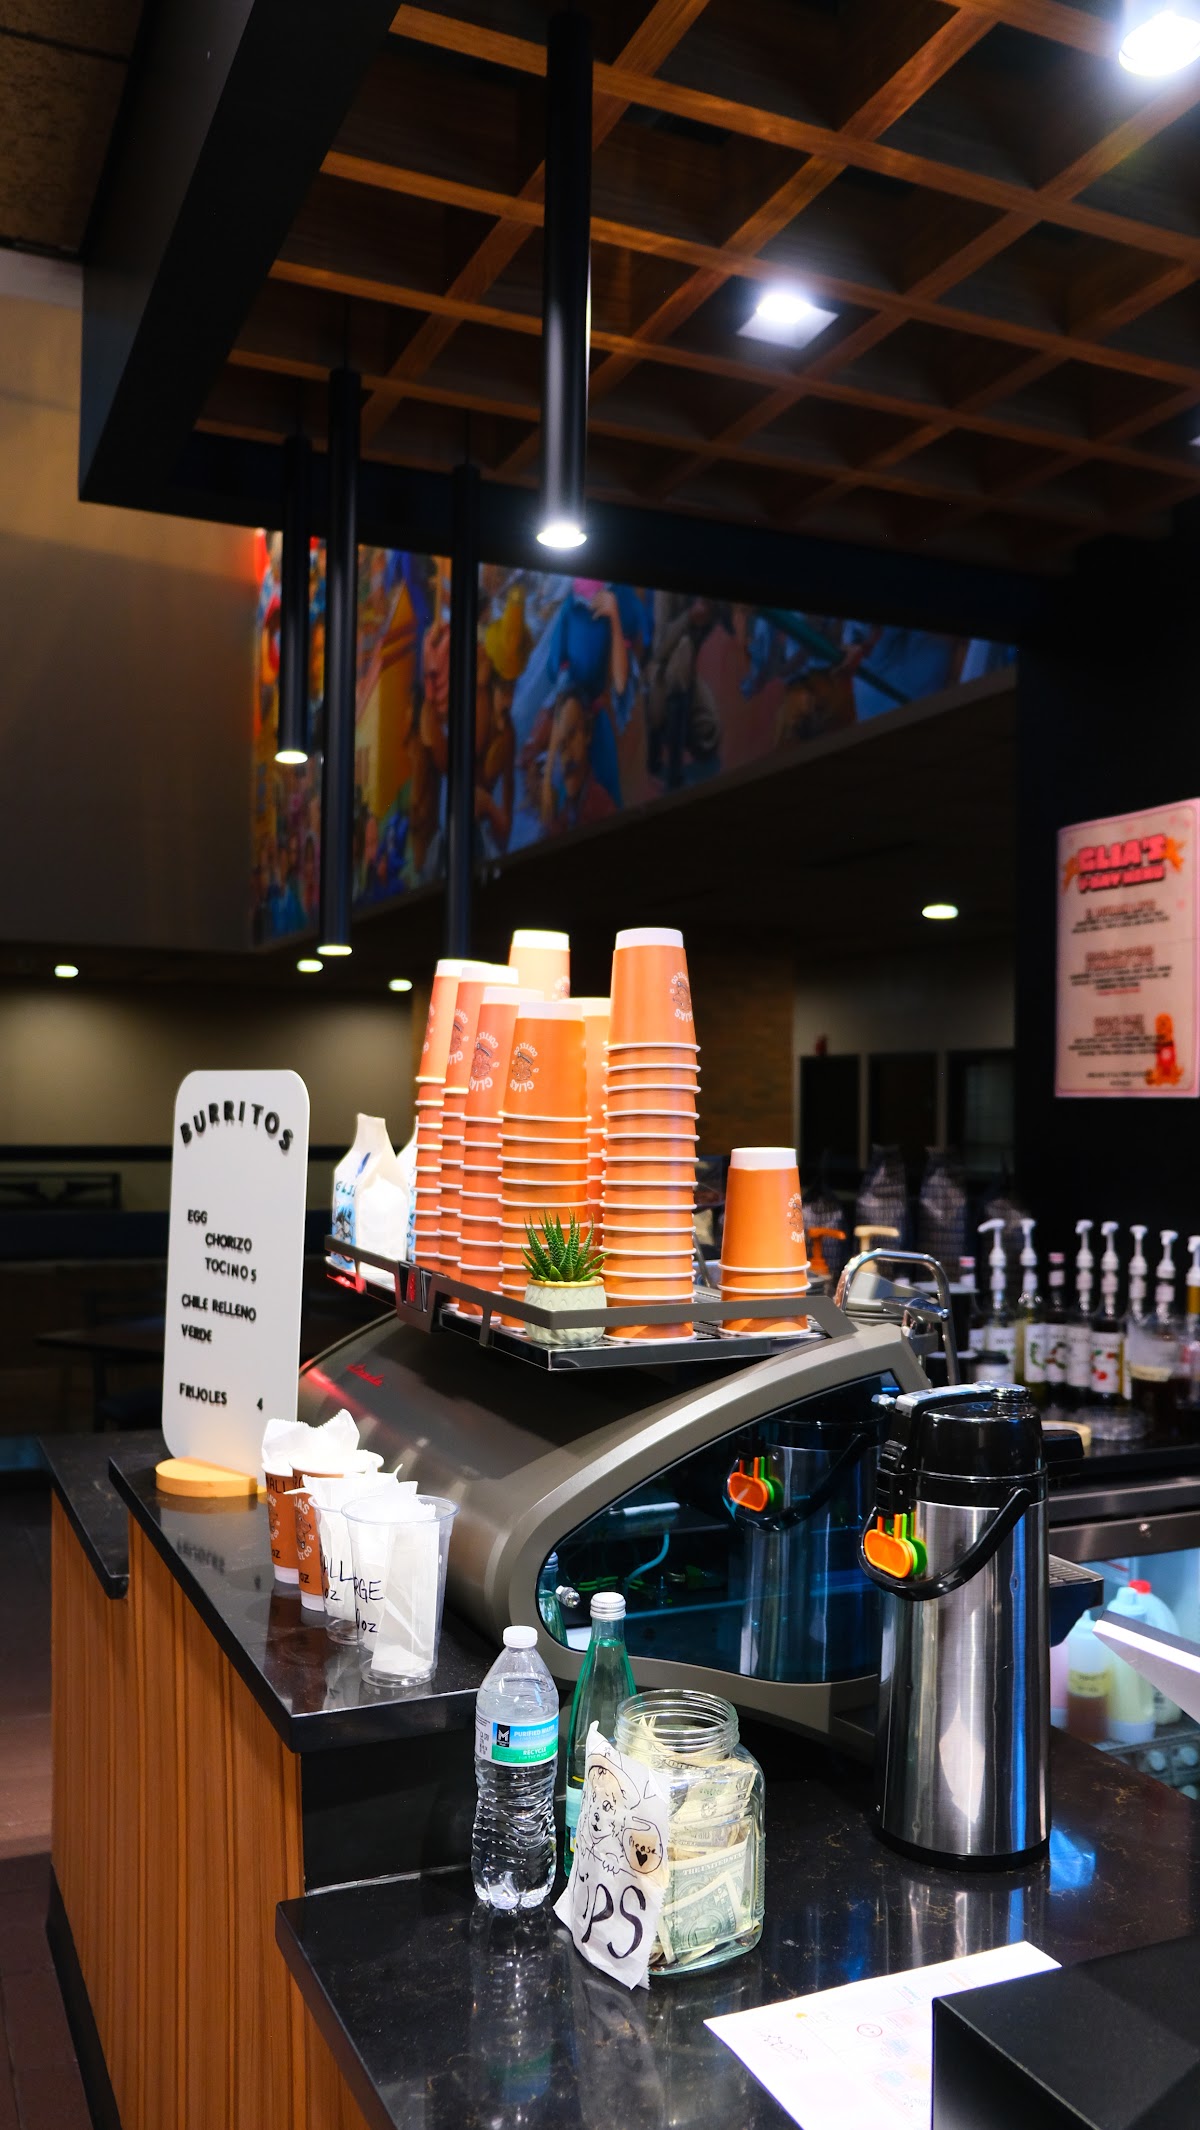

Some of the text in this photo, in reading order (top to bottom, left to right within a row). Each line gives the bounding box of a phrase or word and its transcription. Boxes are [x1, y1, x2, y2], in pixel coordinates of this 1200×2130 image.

[179, 1100, 293, 1151] BURRITOS
[187, 1209, 208, 1224] EGG
[205, 1232, 252, 1251] CHORIZO
[181, 1293, 256, 1321] CHILE RELLENO
[181, 1324, 212, 1342] VERDE
[179, 1382, 263, 1411] FRIJOLES 4
[523, 1746, 547, 1755] RECYCLE
